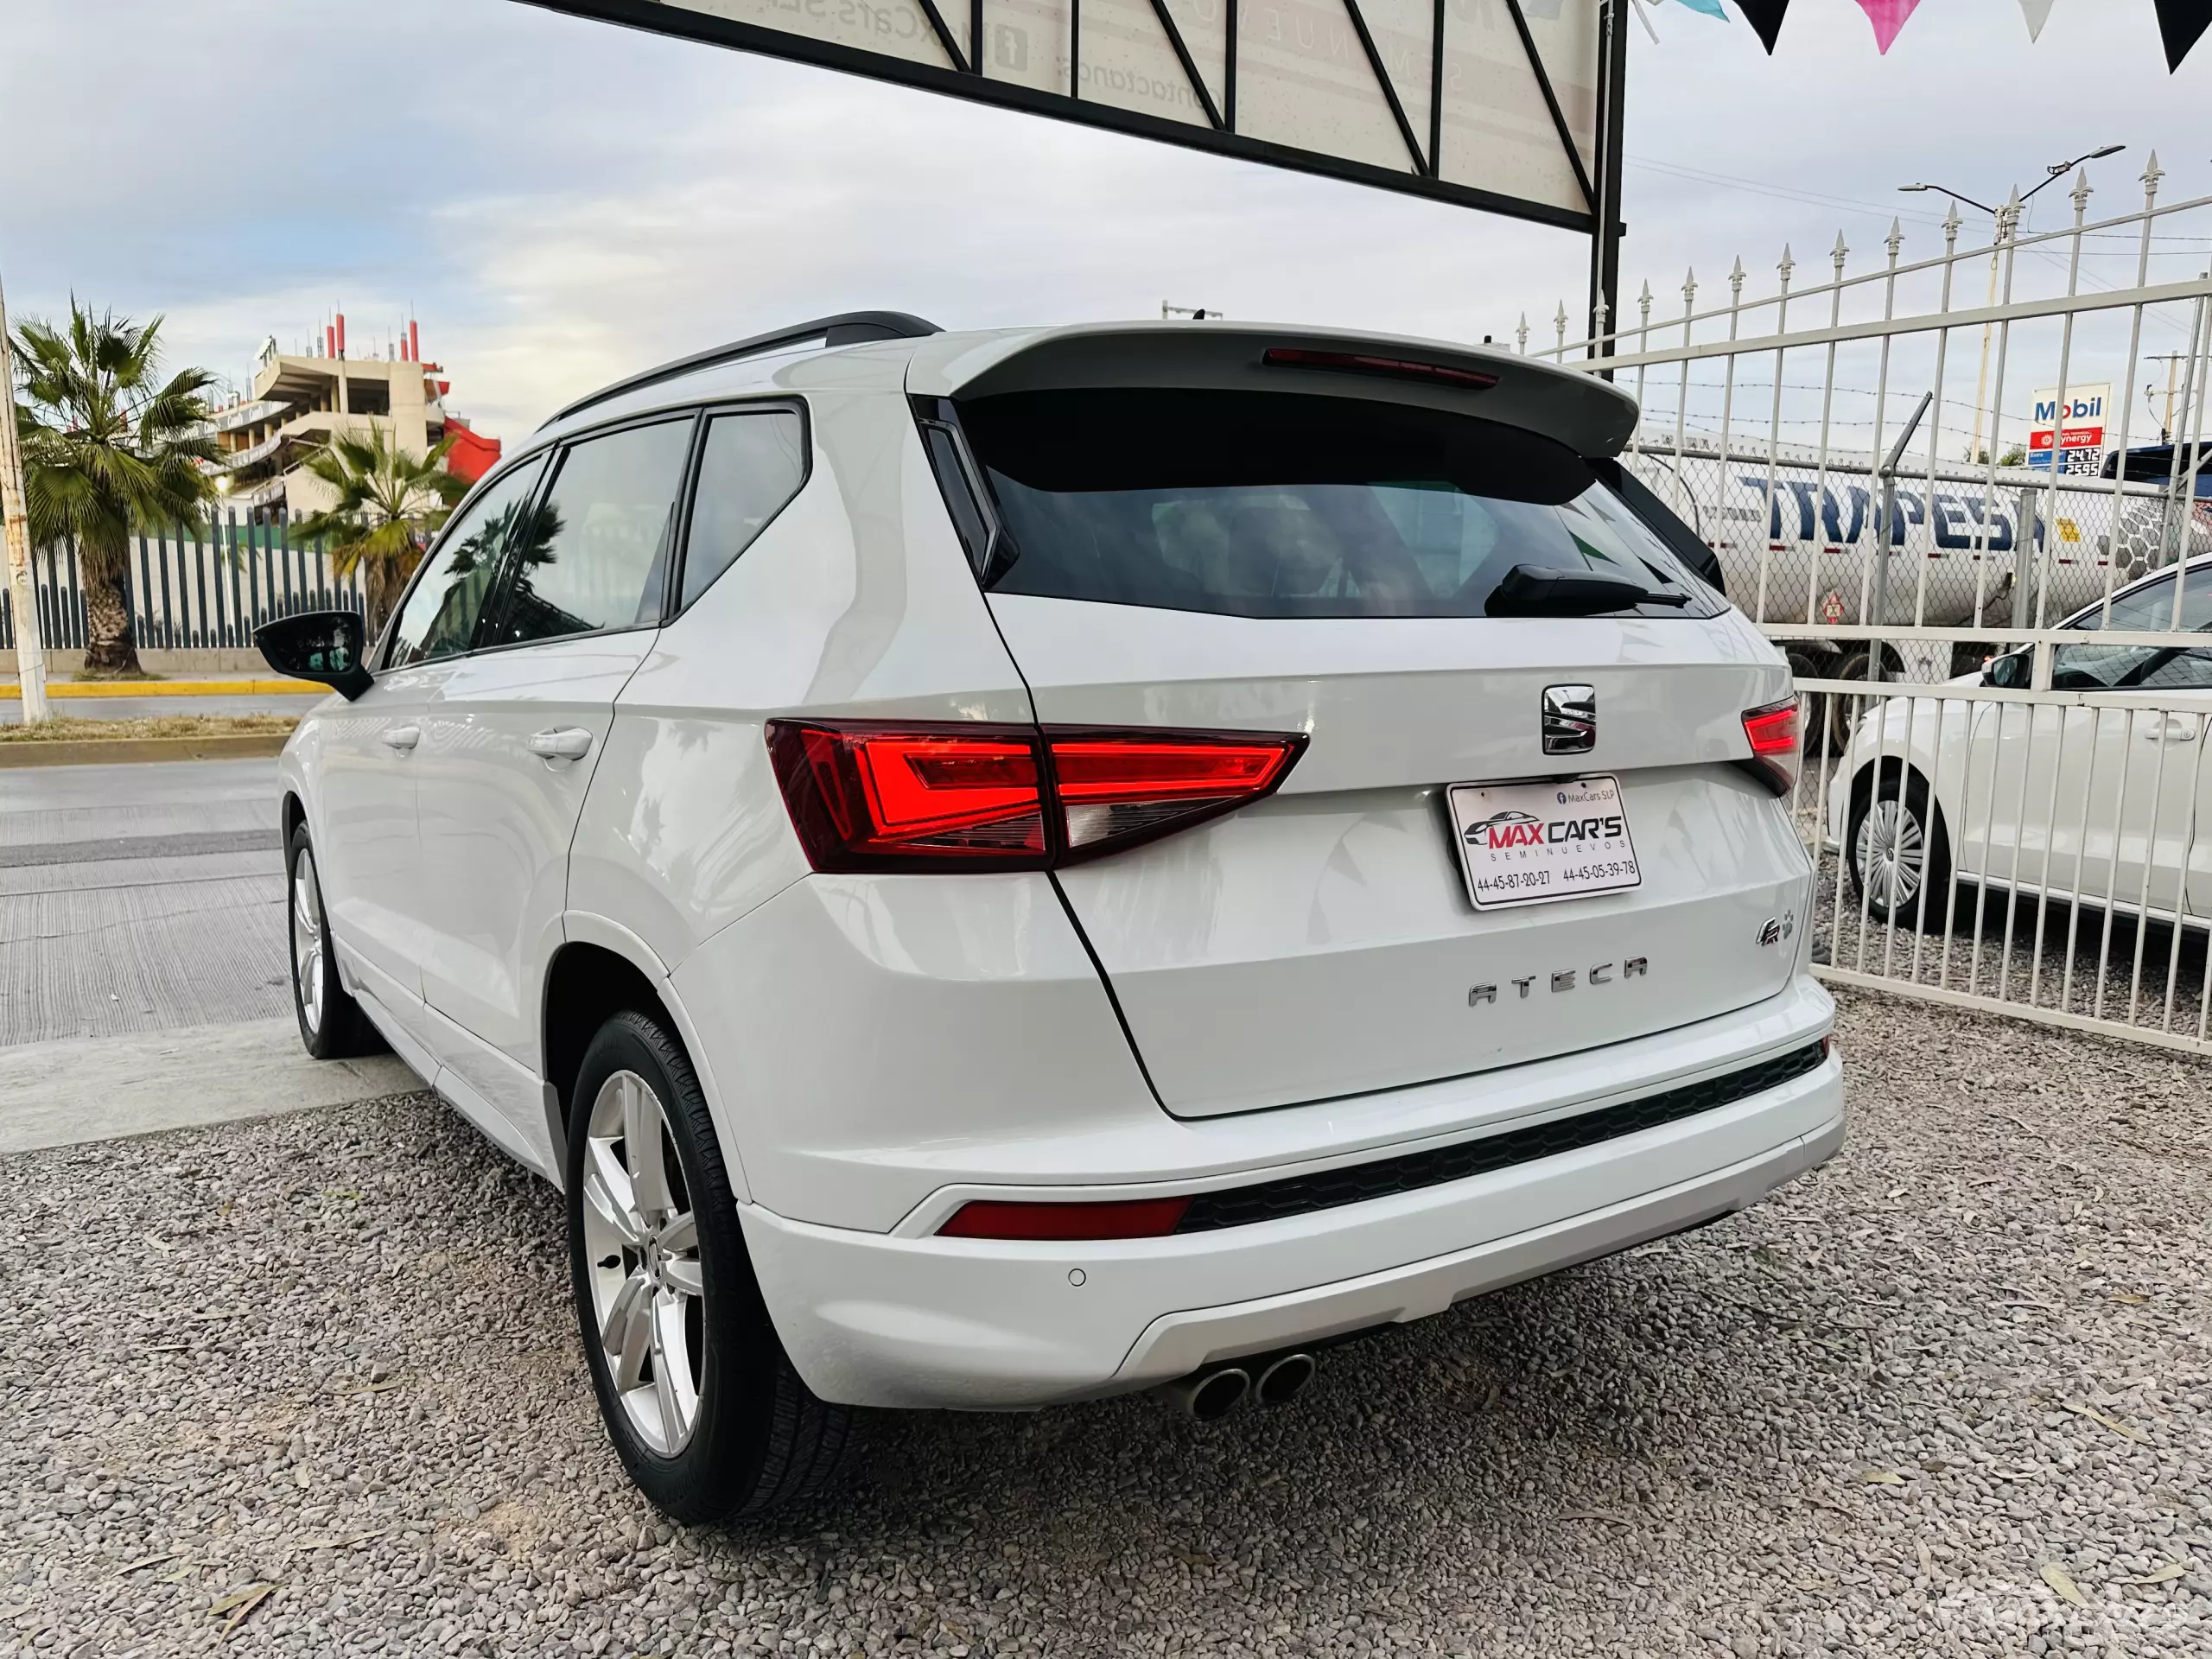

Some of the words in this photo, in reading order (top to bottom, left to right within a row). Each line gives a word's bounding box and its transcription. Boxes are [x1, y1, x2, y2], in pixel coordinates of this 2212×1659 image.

[2034, 397, 2101, 421] Mobil
[2060, 434, 2092, 445] ynergy
[1568, 792, 1600, 804] MaxCars
[1601, 790, 1615, 801] SLP
[1489, 823, 1544, 849] MAX
[1548, 816, 1621, 843] CAR'S
[1491, 840, 1625, 861] SEMINUEVOS
[1478, 871, 1550, 892] 44-45-87-20-27
[1563, 861, 1635, 882] 44-45-05-39-78
[1468, 956, 1649, 1007] ATECA
